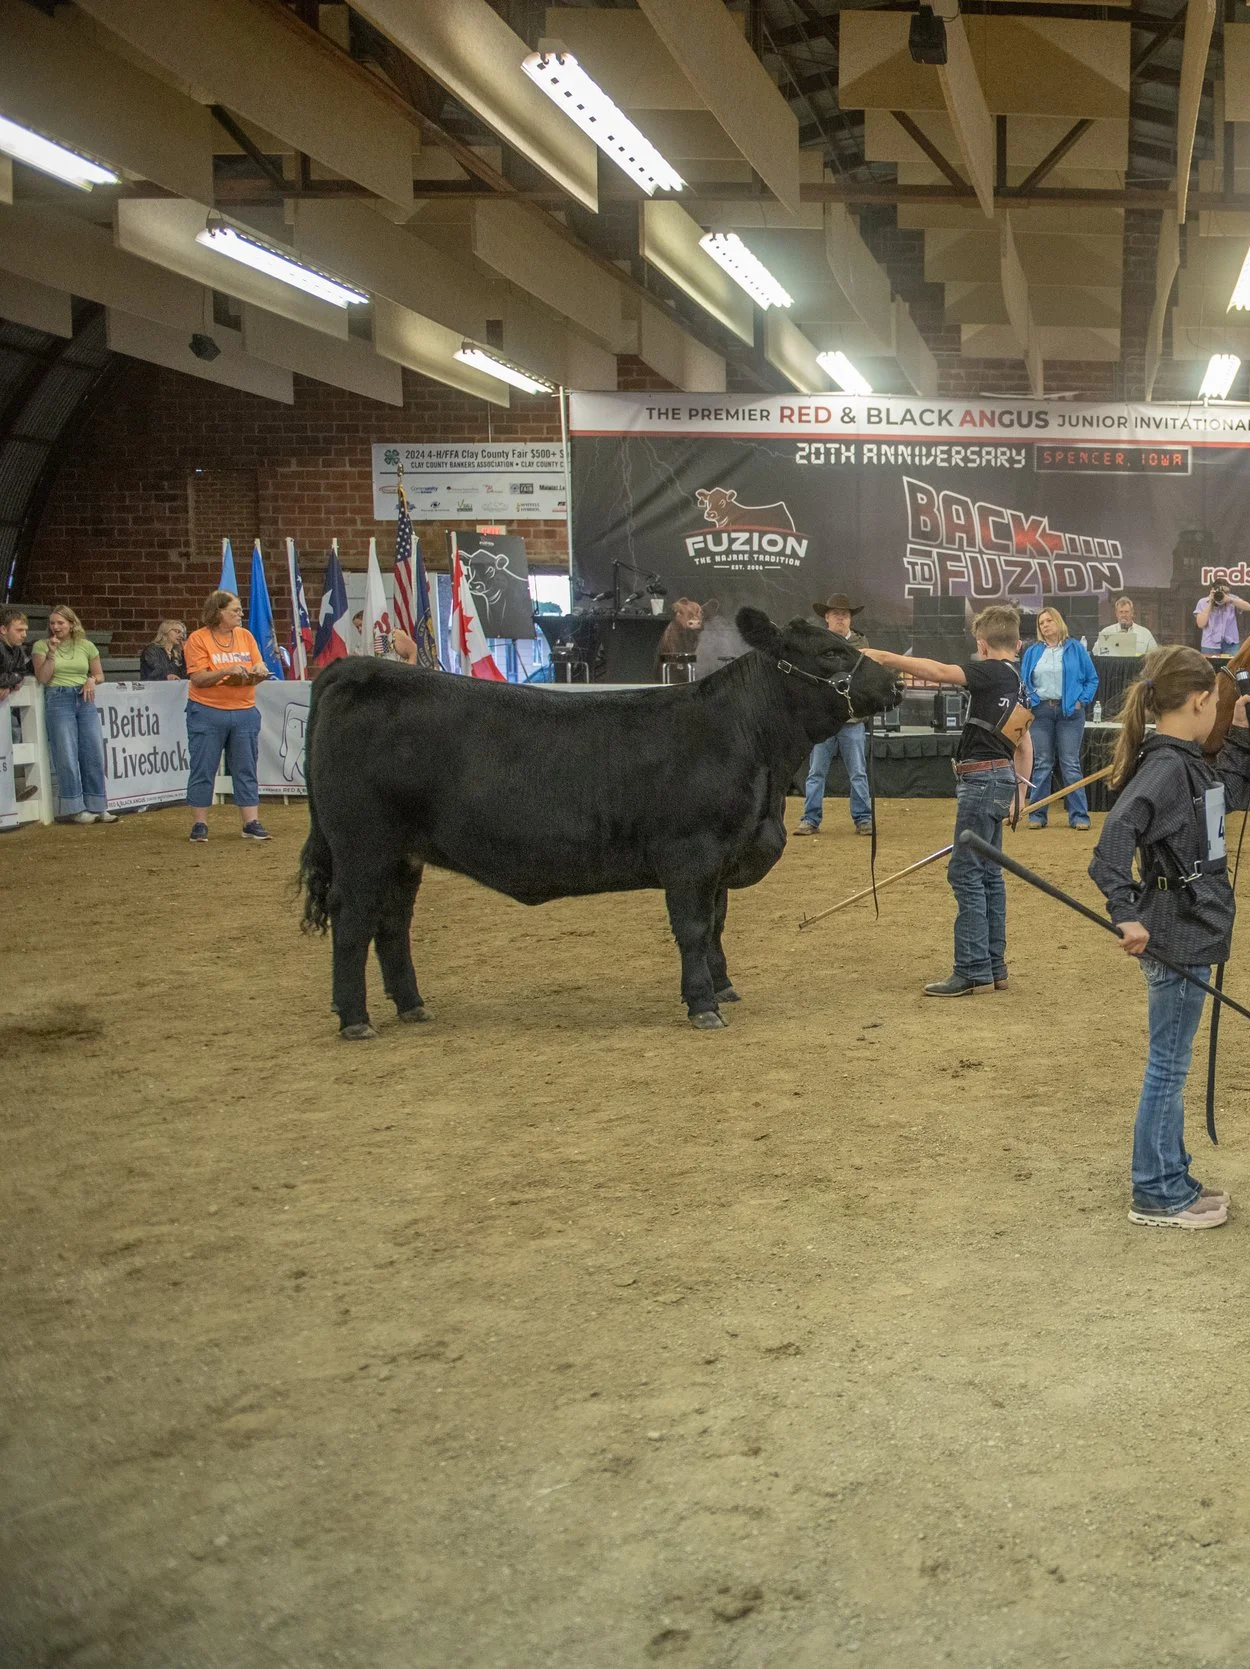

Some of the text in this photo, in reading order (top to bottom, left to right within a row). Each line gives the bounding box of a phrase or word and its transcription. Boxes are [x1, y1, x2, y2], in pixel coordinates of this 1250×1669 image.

[646, 407, 681, 420] THE
[688, 408, 770, 421] PREMIER
[779, 406, 832, 424] RED
[840, 407, 856, 424] &
[866, 407, 954, 427] BLACK
[959, 409, 1050, 429] ANGUS
[1057, 414, 1128, 429] JUNIOR
[405, 449, 425, 459] 2024
[427, 449, 459, 459] 4-H/FFA
[461, 449, 479, 460] Clay
[481, 449, 510, 460] County
[512, 449, 528, 459] Fair
[531, 449, 556, 459] $500+
[795, 443, 1026, 468] 20TH ANNIVERSARY
[1141, 453, 1182, 466] IOWA
[902, 475, 1066, 559] BACK
[685, 532, 808, 558] FUZION
[694, 556, 711, 565] THE
[753, 554, 801, 567] TRADITION
[903, 549, 1124, 599] TO FUZION
[109, 706, 160, 739] Beitia
[112, 741, 189, 779] Livestock
